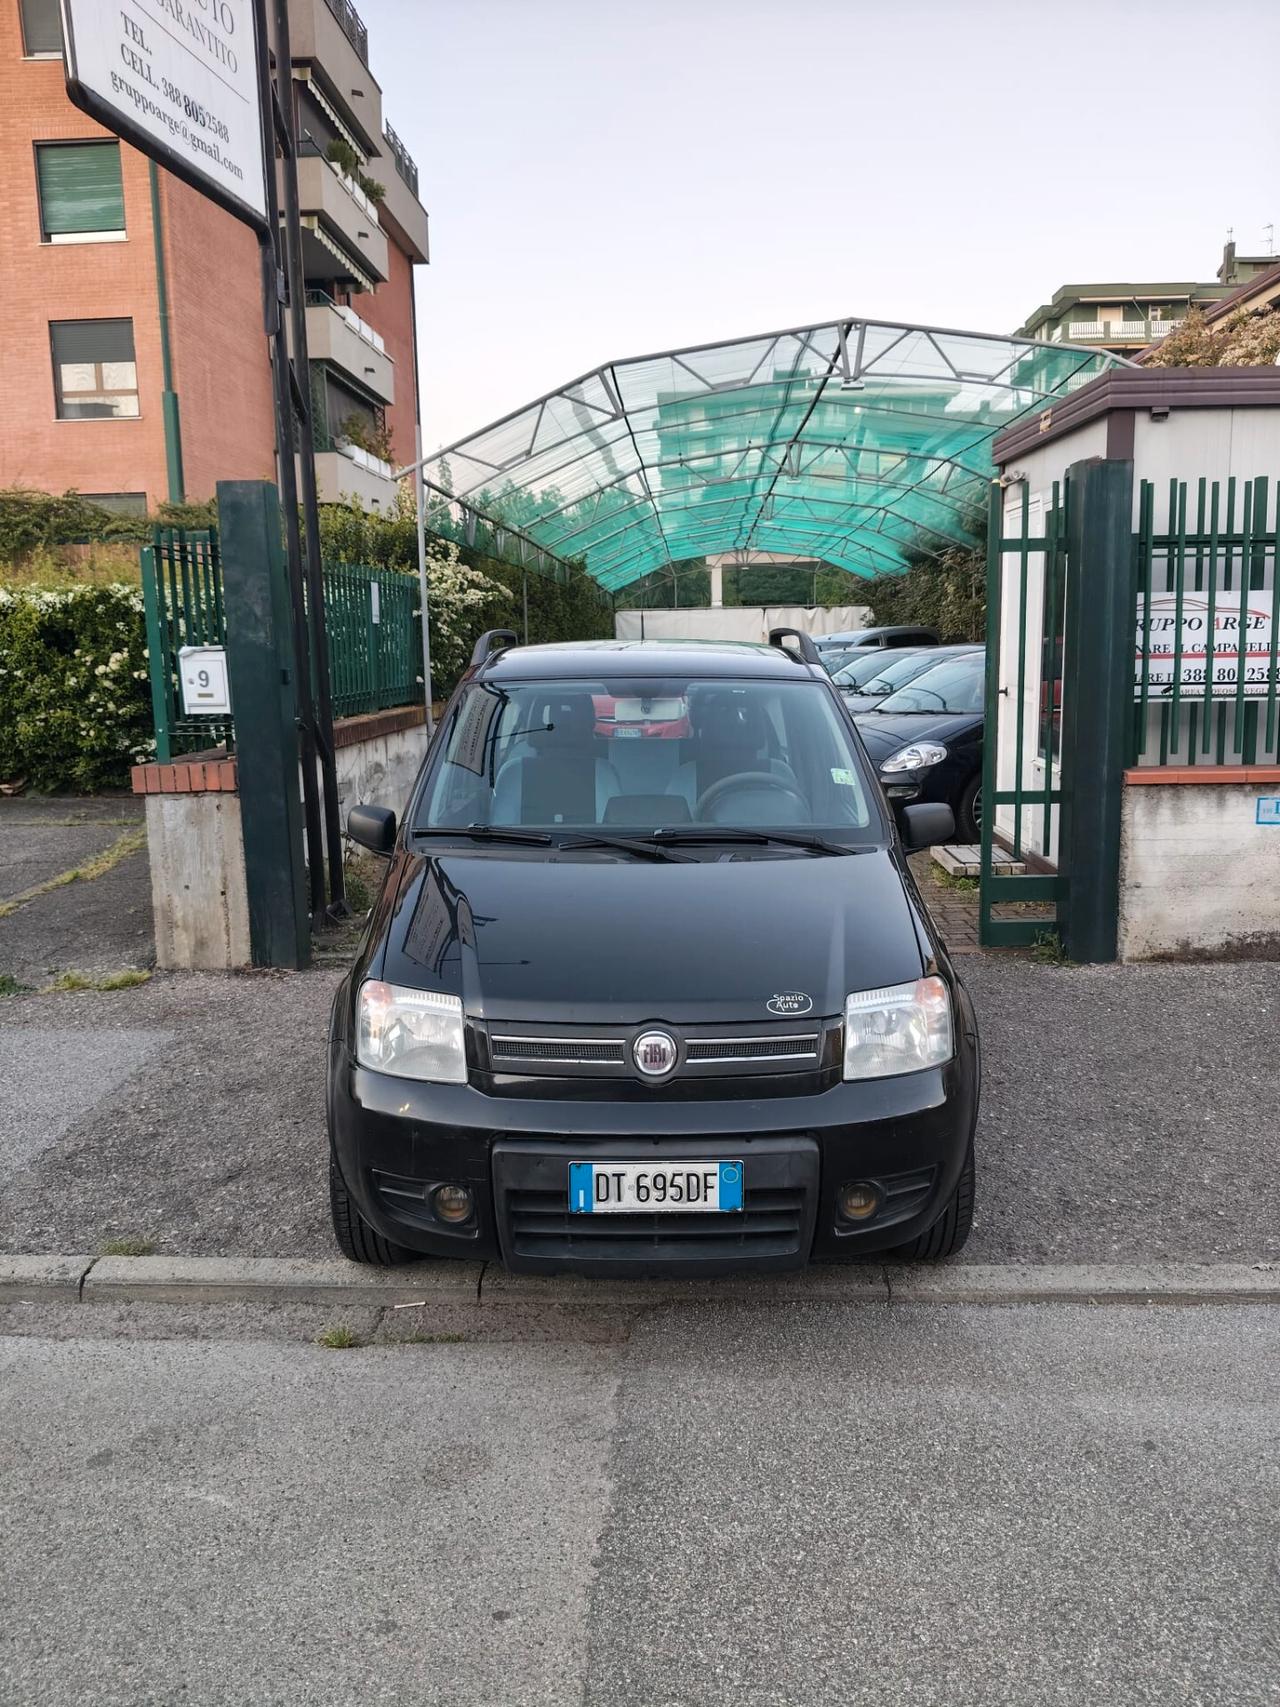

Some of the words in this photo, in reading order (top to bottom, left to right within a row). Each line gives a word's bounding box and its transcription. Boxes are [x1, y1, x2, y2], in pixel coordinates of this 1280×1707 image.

[120, 10, 153, 56] TEL.
[121, 43, 160, 90] CELL.
[161, 77, 182, 108] 388
[110, 71, 244, 181] gruppoarge@gmail.com
[1135, 617, 1203, 631] RUPPO
[198, 670, 210, 688] 9
[773, 994, 804, 1003] Spazio
[776, 1001, 799, 1011] Auto
